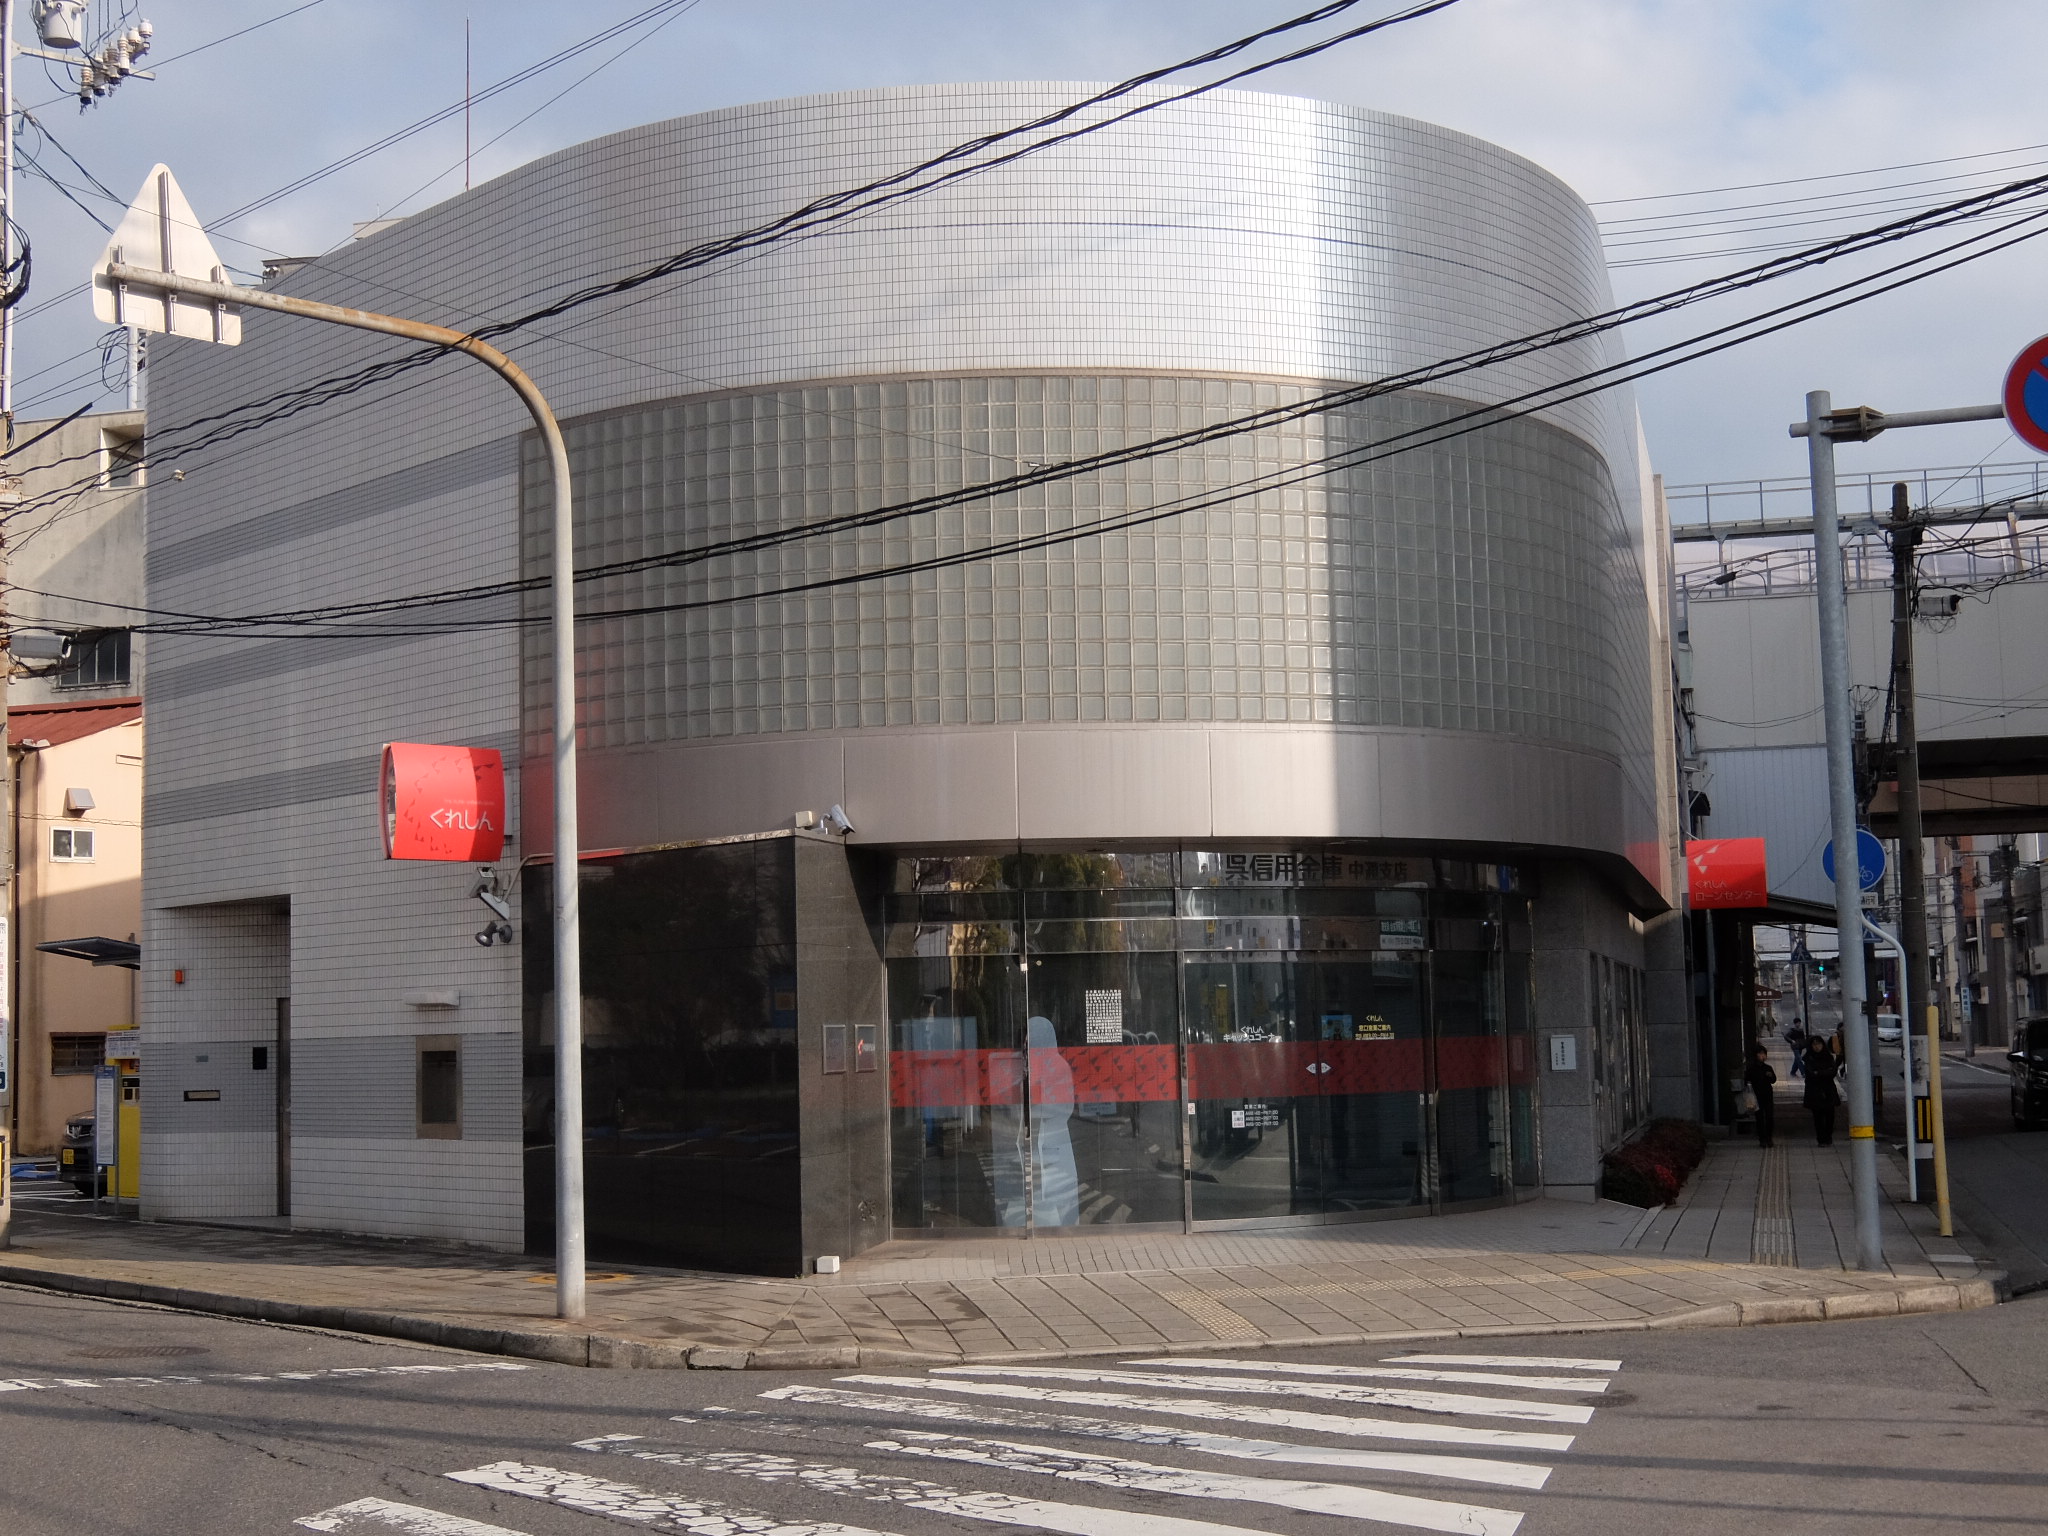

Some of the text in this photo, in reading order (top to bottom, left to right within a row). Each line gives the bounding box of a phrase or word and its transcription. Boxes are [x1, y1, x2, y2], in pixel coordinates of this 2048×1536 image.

[430, 808, 494, 831] くれしん
[1225, 855, 1342, 881] 呉信用金庫
[1695, 880, 1727, 888] くれしん
[1695, 891, 1761, 901] ローンセンター
[1240, 1026, 1264, 1034] くれしん
